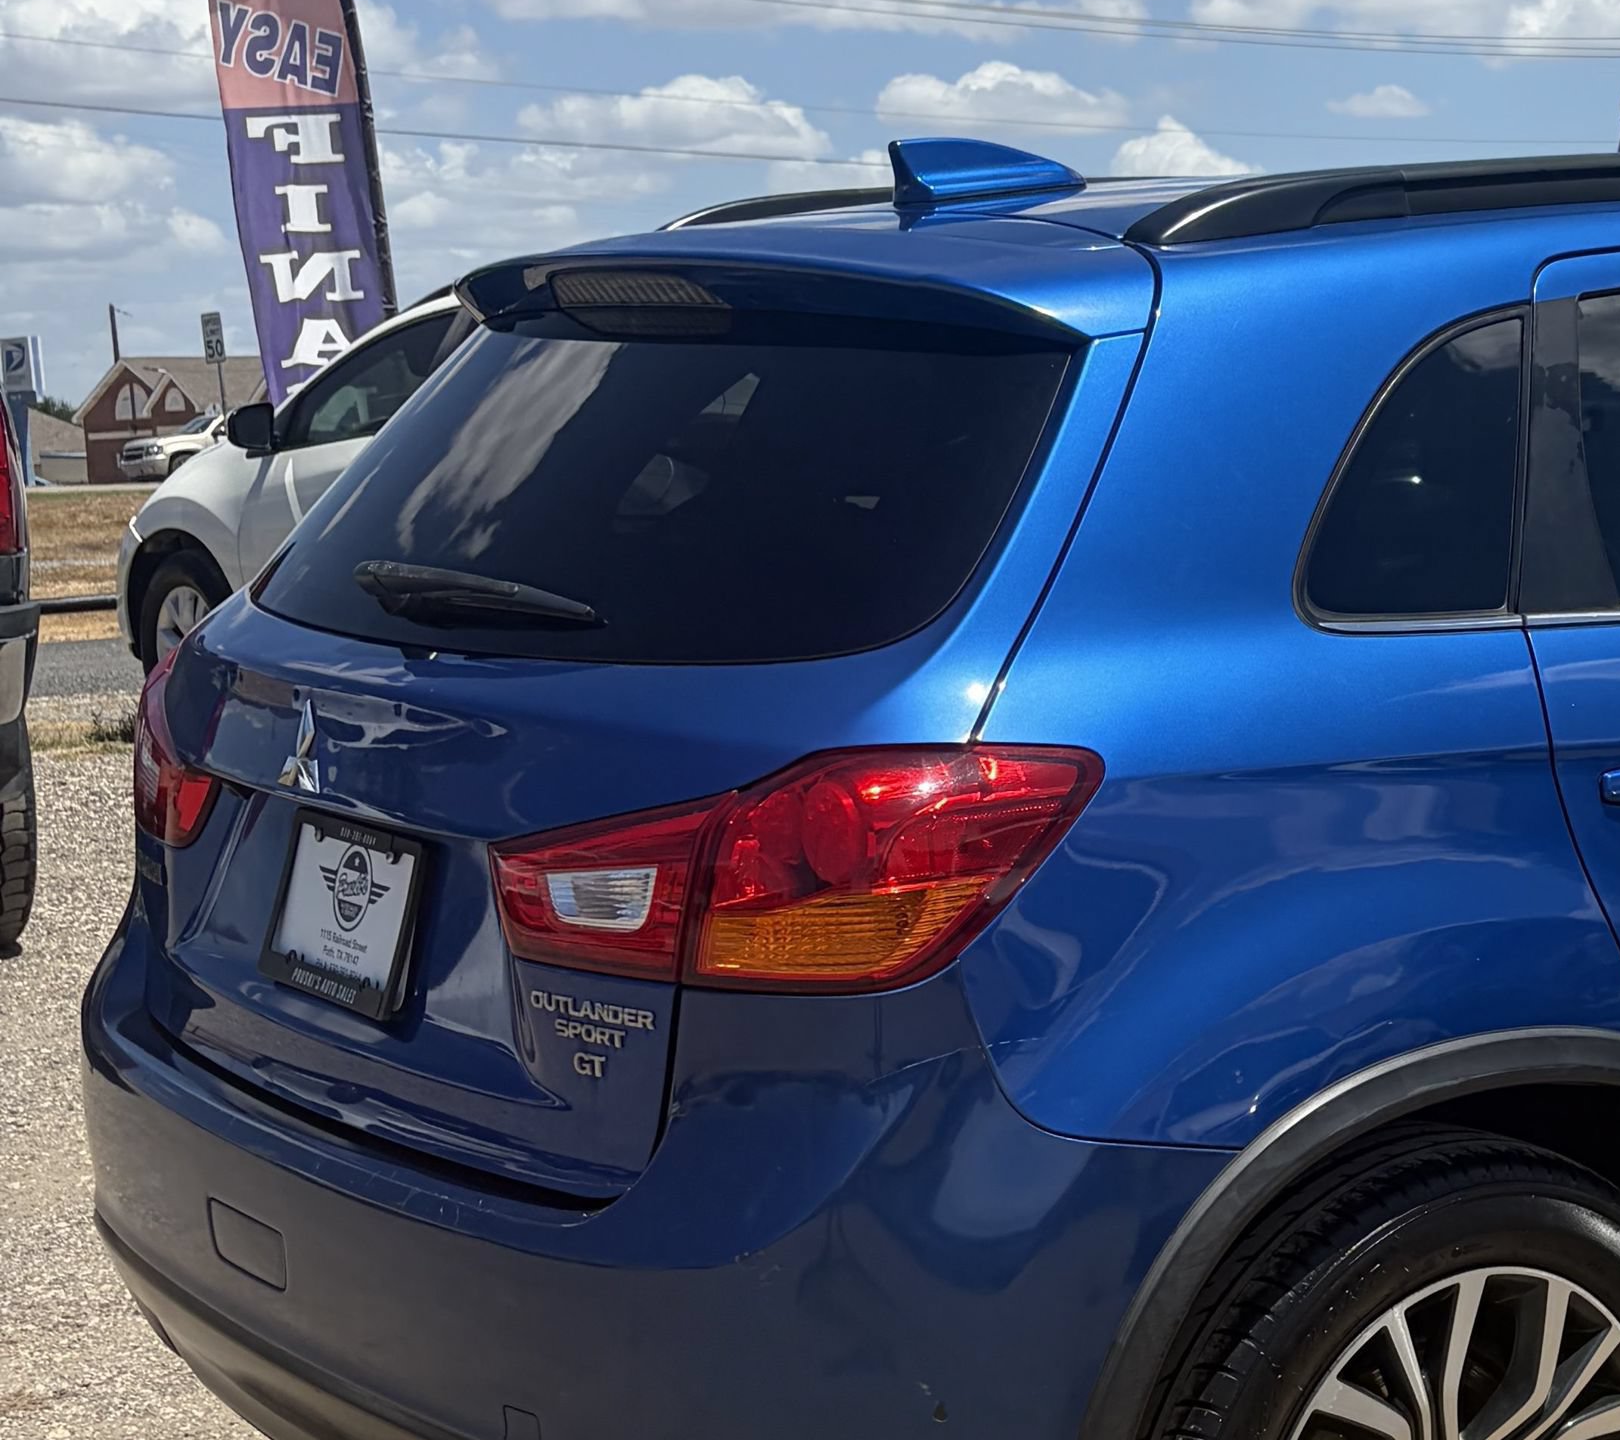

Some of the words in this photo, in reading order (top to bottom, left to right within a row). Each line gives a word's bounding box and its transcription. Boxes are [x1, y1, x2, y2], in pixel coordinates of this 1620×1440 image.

[206, 338, 224, 359] 50
[530, 990, 655, 1030] OUTLANDER
[554, 1018, 626, 1049] SPORT
[573, 1051, 606, 1078] GT
